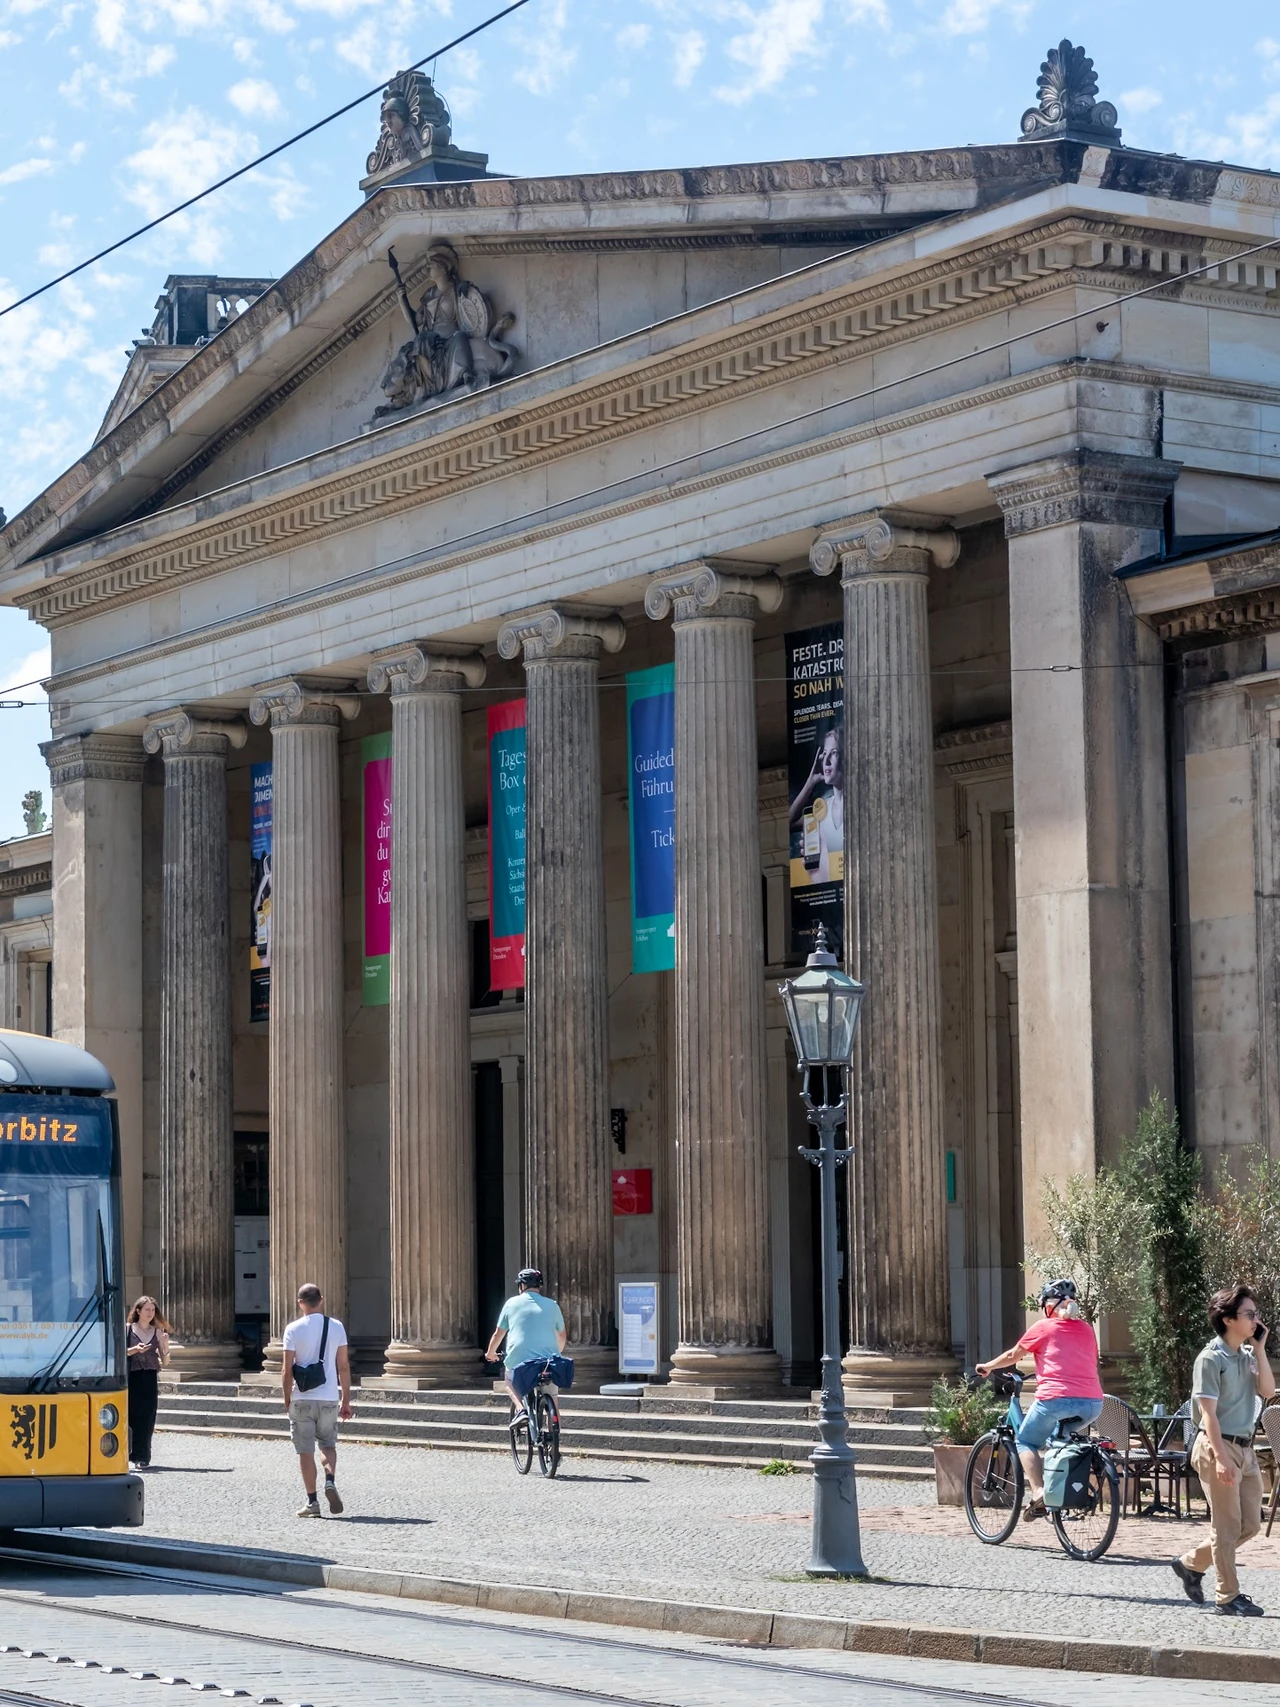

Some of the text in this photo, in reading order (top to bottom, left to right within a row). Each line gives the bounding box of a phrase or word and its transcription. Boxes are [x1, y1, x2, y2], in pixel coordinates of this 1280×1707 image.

[793, 639, 844, 662] FESTE. DR
[794, 684, 807, 699] SO
[809, 677, 831, 695] NAH
[821, 709, 836, 717] EVER.
[634, 748, 674, 773] Guided
[499, 772, 519, 790] Box
[641, 777, 674, 798] Führu
[505, 805, 520, 817] Oper
[651, 827, 675, 848] Tick
[376, 842, 388, 861] du
